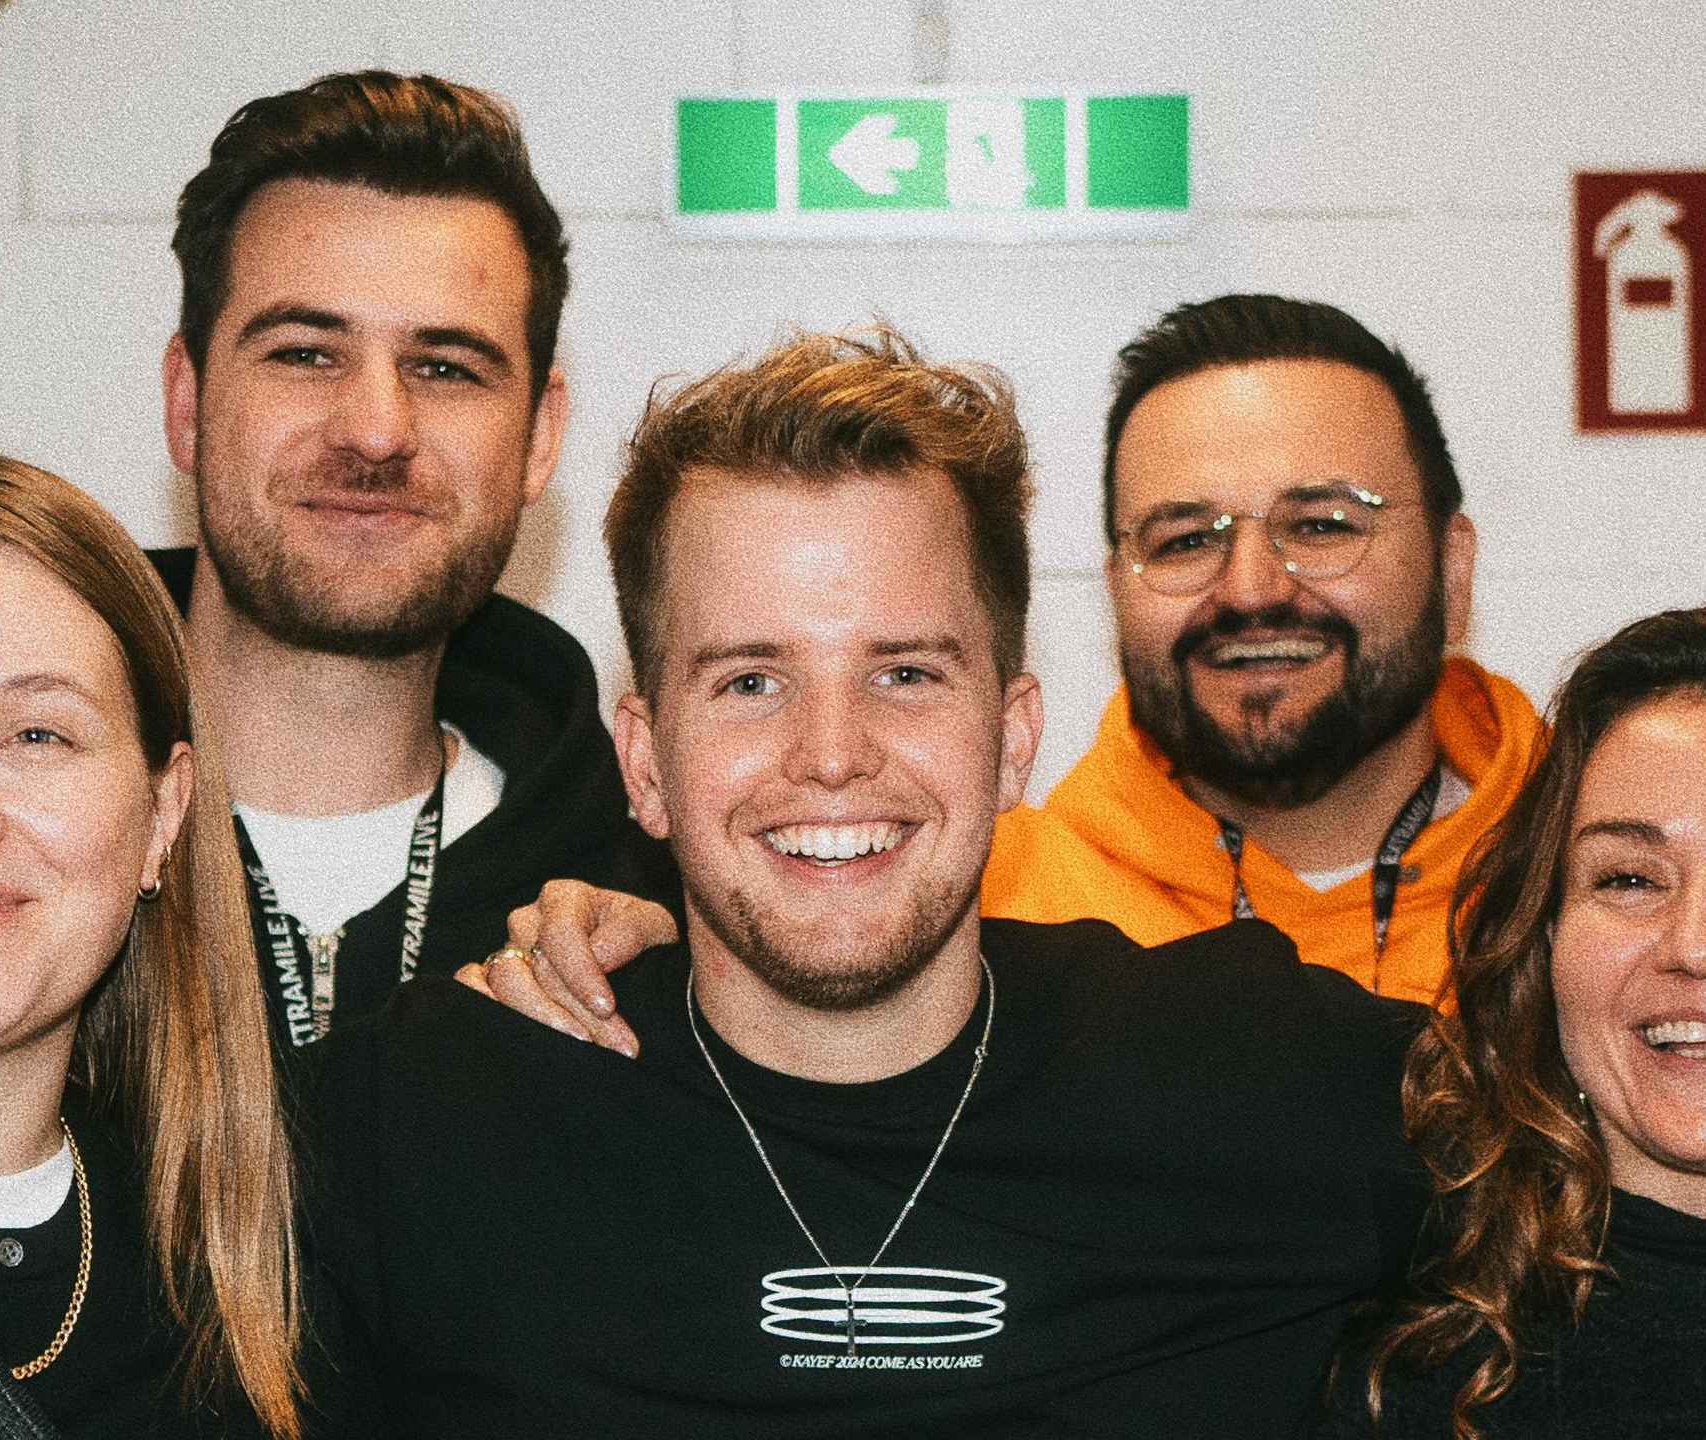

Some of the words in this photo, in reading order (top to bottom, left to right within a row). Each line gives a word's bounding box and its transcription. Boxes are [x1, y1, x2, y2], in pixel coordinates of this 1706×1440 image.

[792, 1354, 836, 1368] KAYEF
[835, 1356, 865, 1368] 2024
[866, 1356, 907, 1369] COME
[905, 1356, 926, 1369] AS
[926, 1356, 957, 1369] YOU
[954, 1354, 983, 1368] ARE
